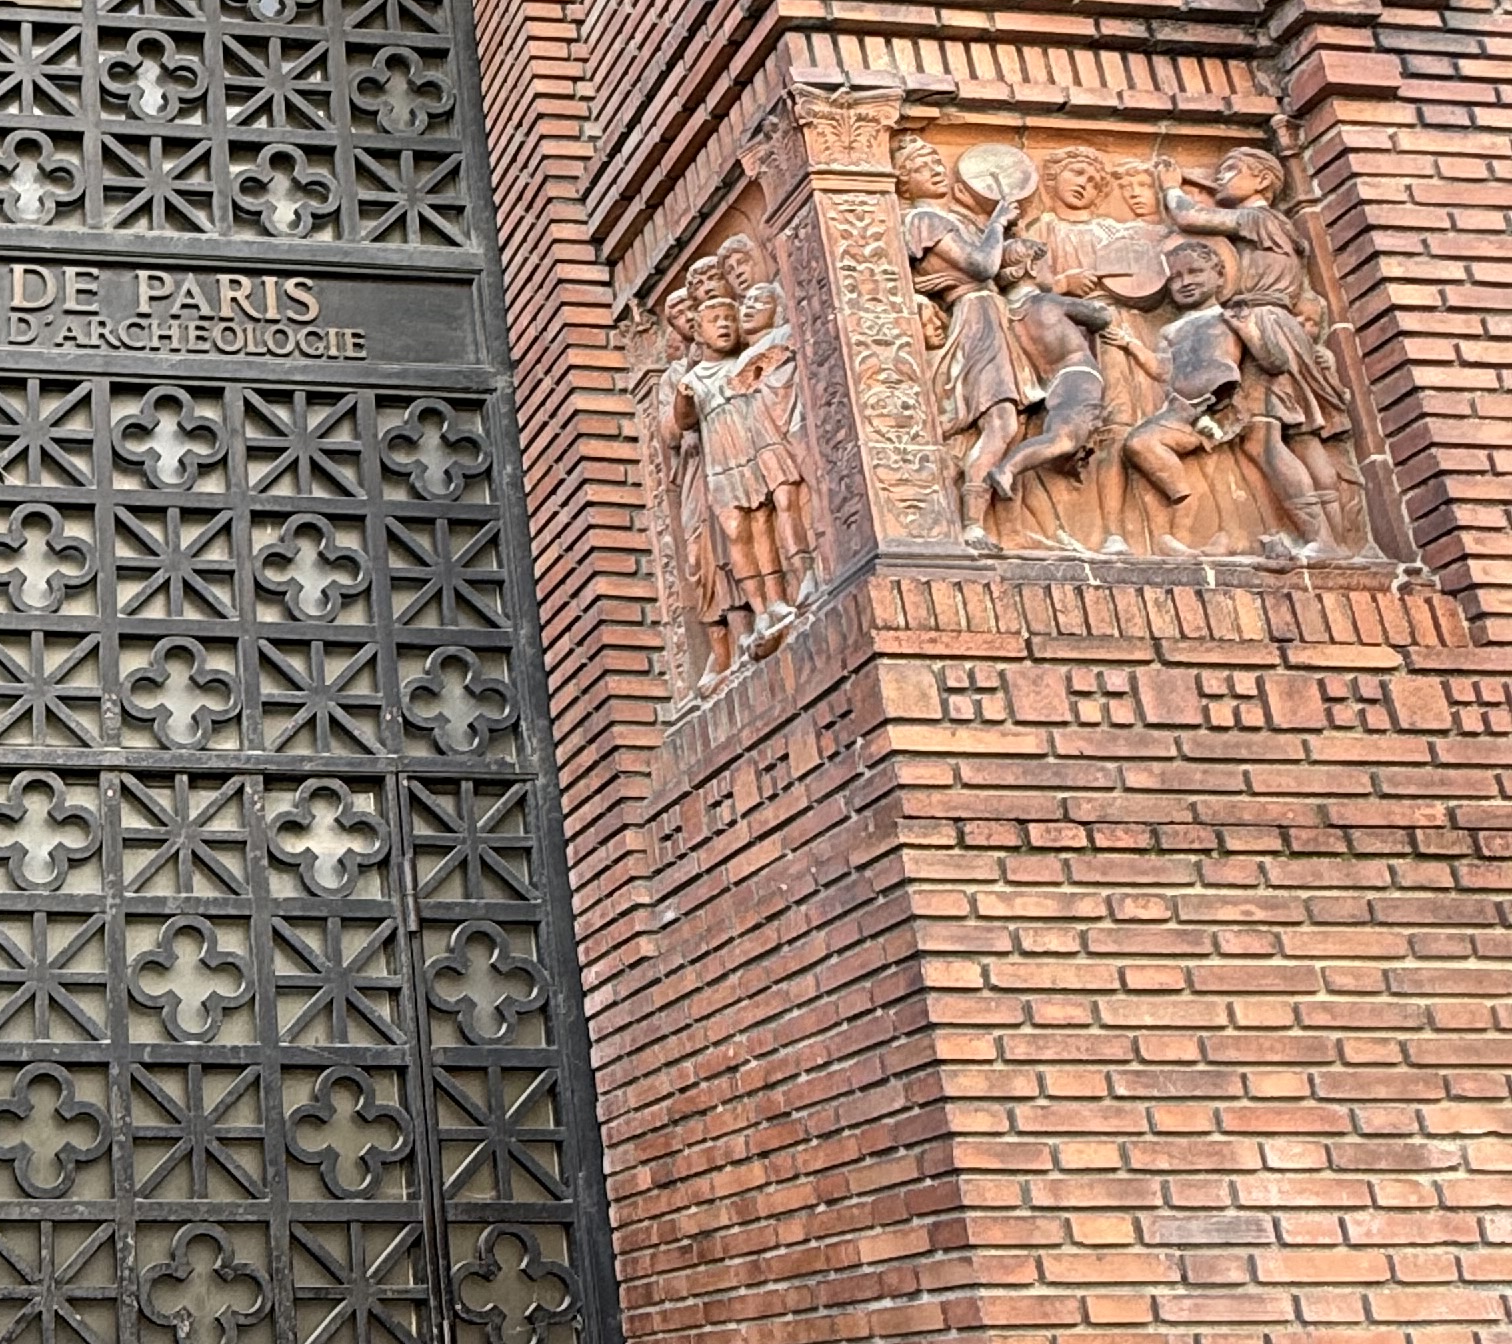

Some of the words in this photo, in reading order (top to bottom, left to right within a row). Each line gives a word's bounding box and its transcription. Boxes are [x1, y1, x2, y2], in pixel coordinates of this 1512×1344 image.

[8, 264, 100, 313] DE
[135, 270, 320, 322] PARIS
[8, 312, 367, 360] D'ARCHEOLOGIE
